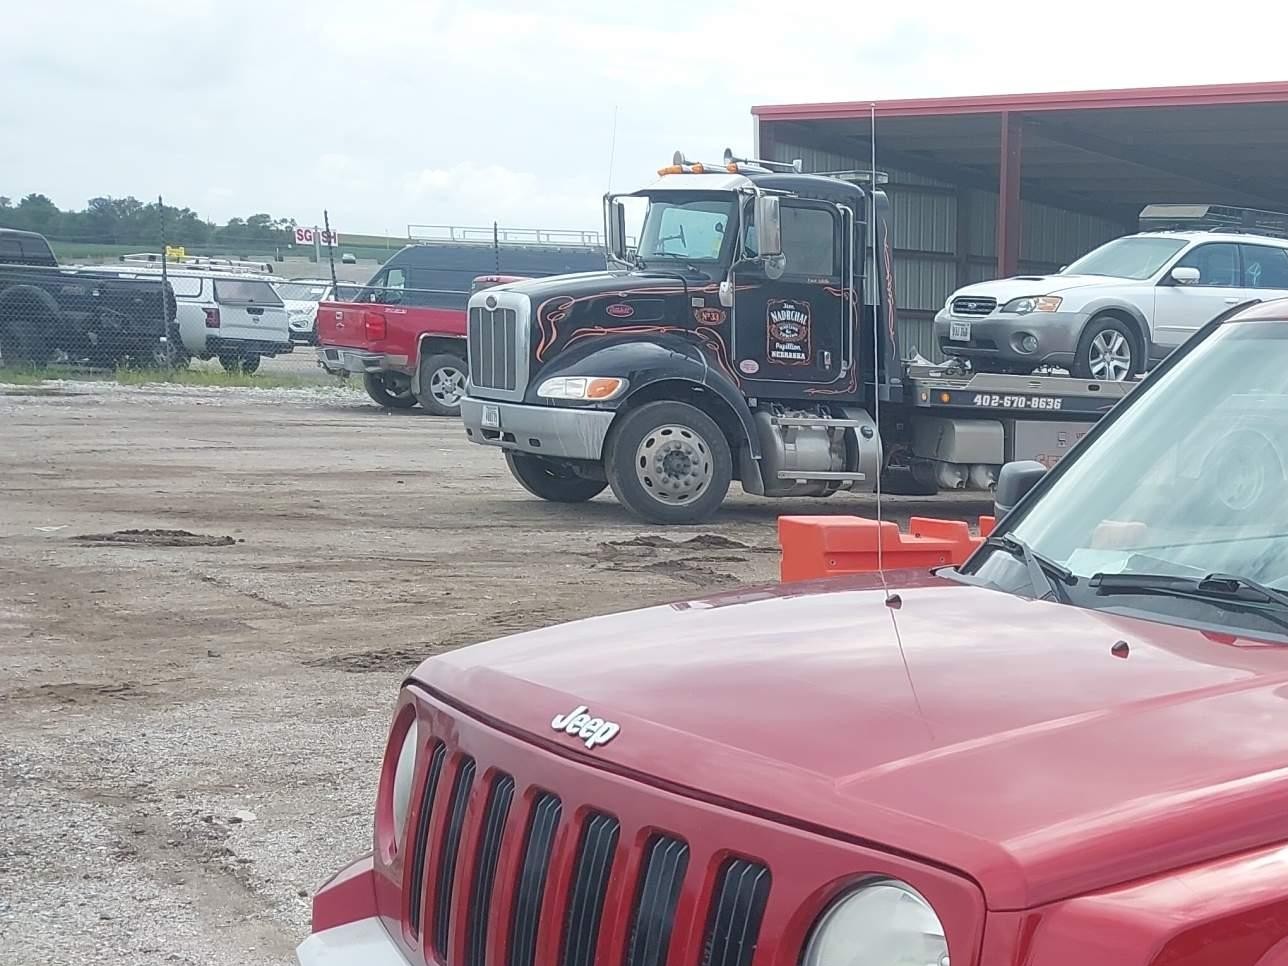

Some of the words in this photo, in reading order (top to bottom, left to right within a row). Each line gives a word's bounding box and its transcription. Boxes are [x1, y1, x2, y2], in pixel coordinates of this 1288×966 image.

[296, 229, 313, 242] SG
[973, 394, 1063, 410] 402-670-8636
[551, 705, 621, 749] Jeep
